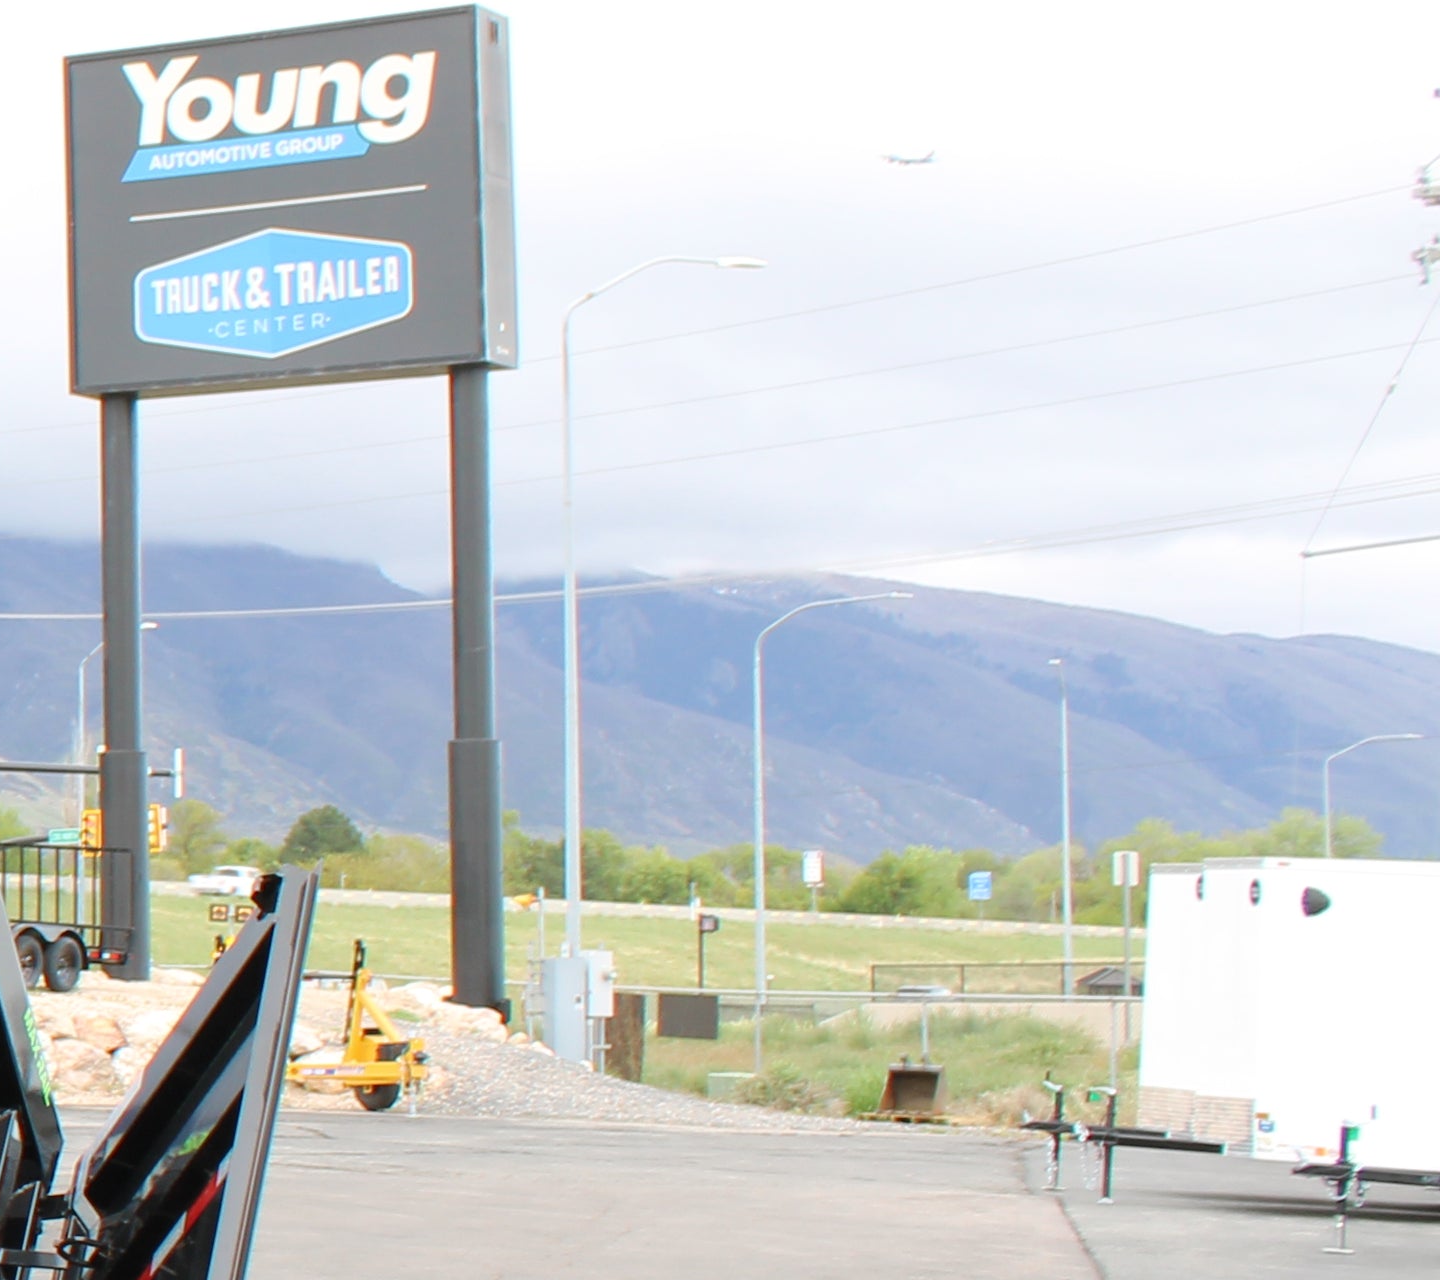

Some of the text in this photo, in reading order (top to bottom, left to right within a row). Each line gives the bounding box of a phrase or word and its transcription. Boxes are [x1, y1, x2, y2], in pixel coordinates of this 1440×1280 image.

[122, 51, 437, 146] Young
[148, 132, 343, 171] AUTOMOTIVE GROUP
[151, 256, 400, 315] TRUCK & TRAILER
[214, 313, 326, 339] CENTER
